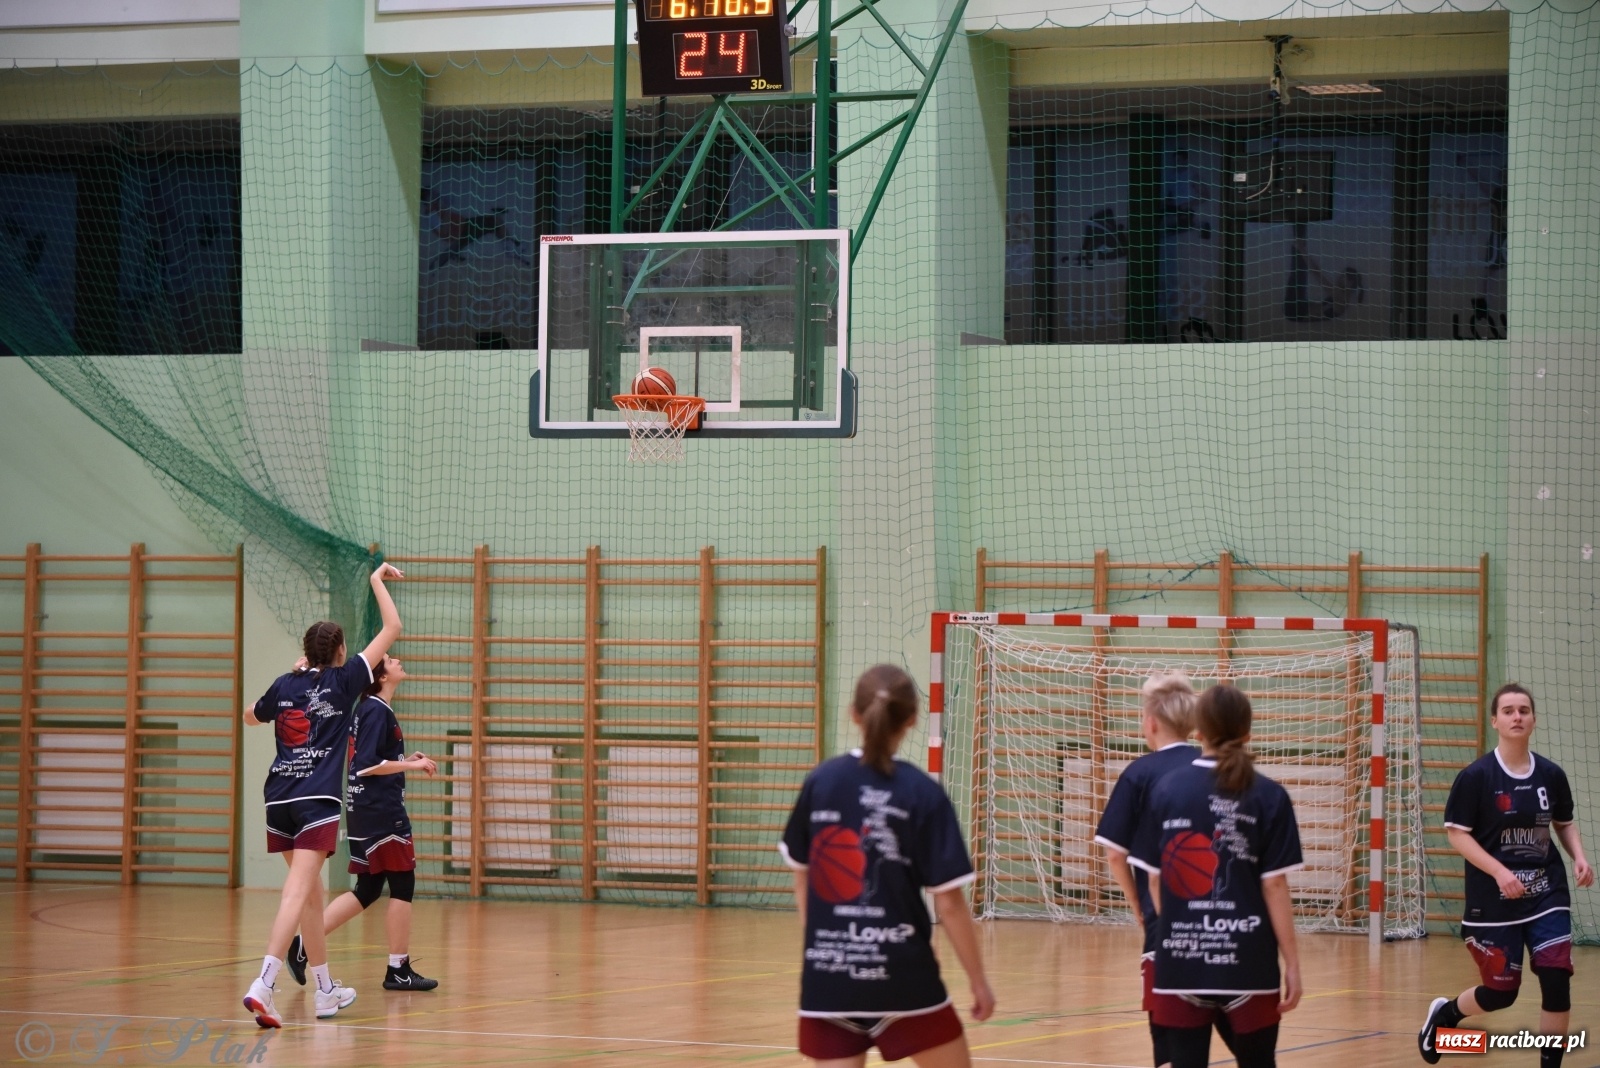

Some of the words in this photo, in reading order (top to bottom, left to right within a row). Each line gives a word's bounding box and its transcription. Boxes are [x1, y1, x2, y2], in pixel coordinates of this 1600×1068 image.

[679, 32, 746, 76] 24
[750, 79, 767, 90] 3D
[1537, 786, 1549, 811] 8
[1171, 921, 1194, 931] What
[1203, 914, 1261, 932] Love?
[848, 921, 916, 943] Love?
[1171, 931, 1190, 939] Love
[1200, 932, 1231, 941] playing
[1200, 942, 1223, 950] game
[1223, 941, 1238, 949] like
[1185, 951, 1204, 960] your
[1204, 951, 1240, 965] Last.
